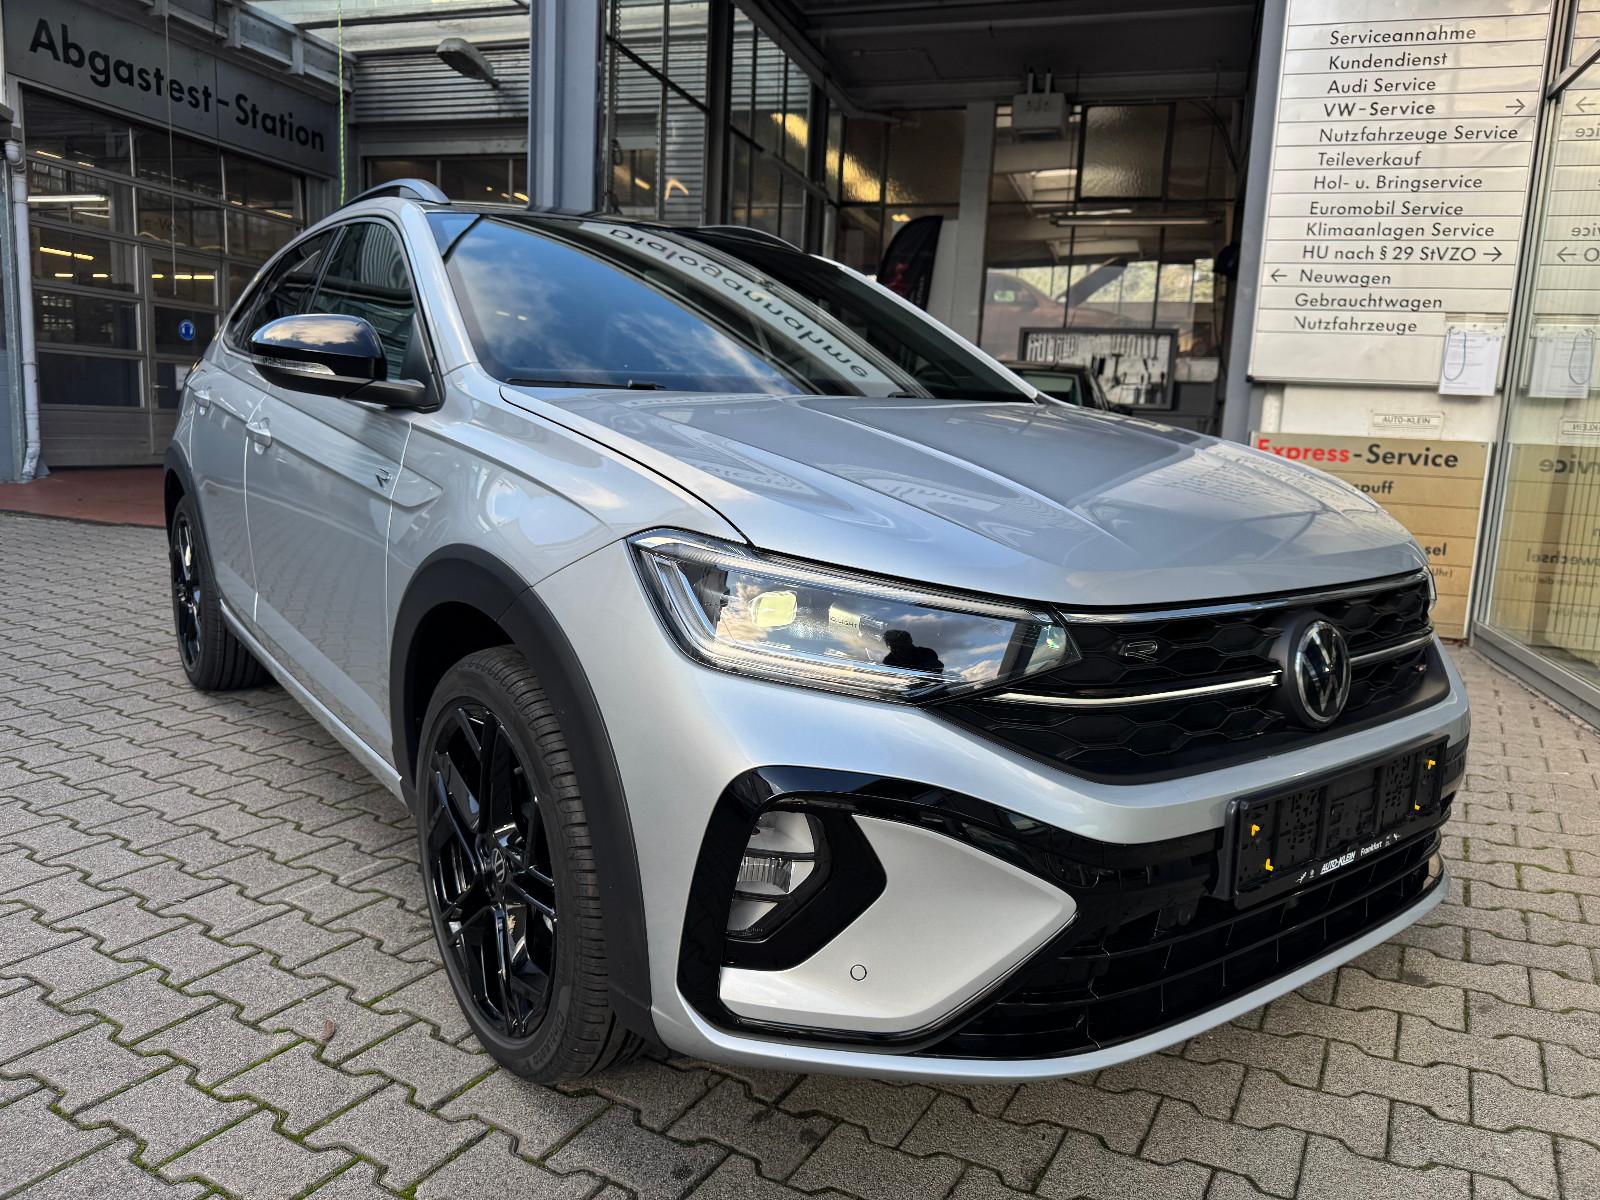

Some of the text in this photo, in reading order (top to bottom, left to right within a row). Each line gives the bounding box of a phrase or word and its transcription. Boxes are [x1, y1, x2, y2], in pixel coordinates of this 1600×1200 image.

[1330, 25, 1477, 45] Serviceannahme
[1329, 52, 1448, 71] Kundendienst
[29, 18, 325, 152] Abgastest-Station
[1327, 78, 1436, 95] Audi Service
[1323, 102, 1436, 117] VW-Service
[1319, 125, 1519, 144] Nutzfahrzeuge Service
[1318, 151, 1422, 167] Teileverkauf
[1313, 175, 1483, 192] Hol- u. Bringservice
[1309, 200, 1463, 216] Euromobil Service
[1306, 222, 1495, 240] Klimaanlagen Service
[1302, 245, 1476, 262] HU nach § 29 StVZO
[1299, 269, 1391, 287] Neuwagen
[1295, 293, 1442, 311] Gebrauchtwagen
[1295, 316, 1417, 335] Nutzfahrzeuge
[1320, 841, 1383, 874] AUTO-KLEIN Frankfurt
